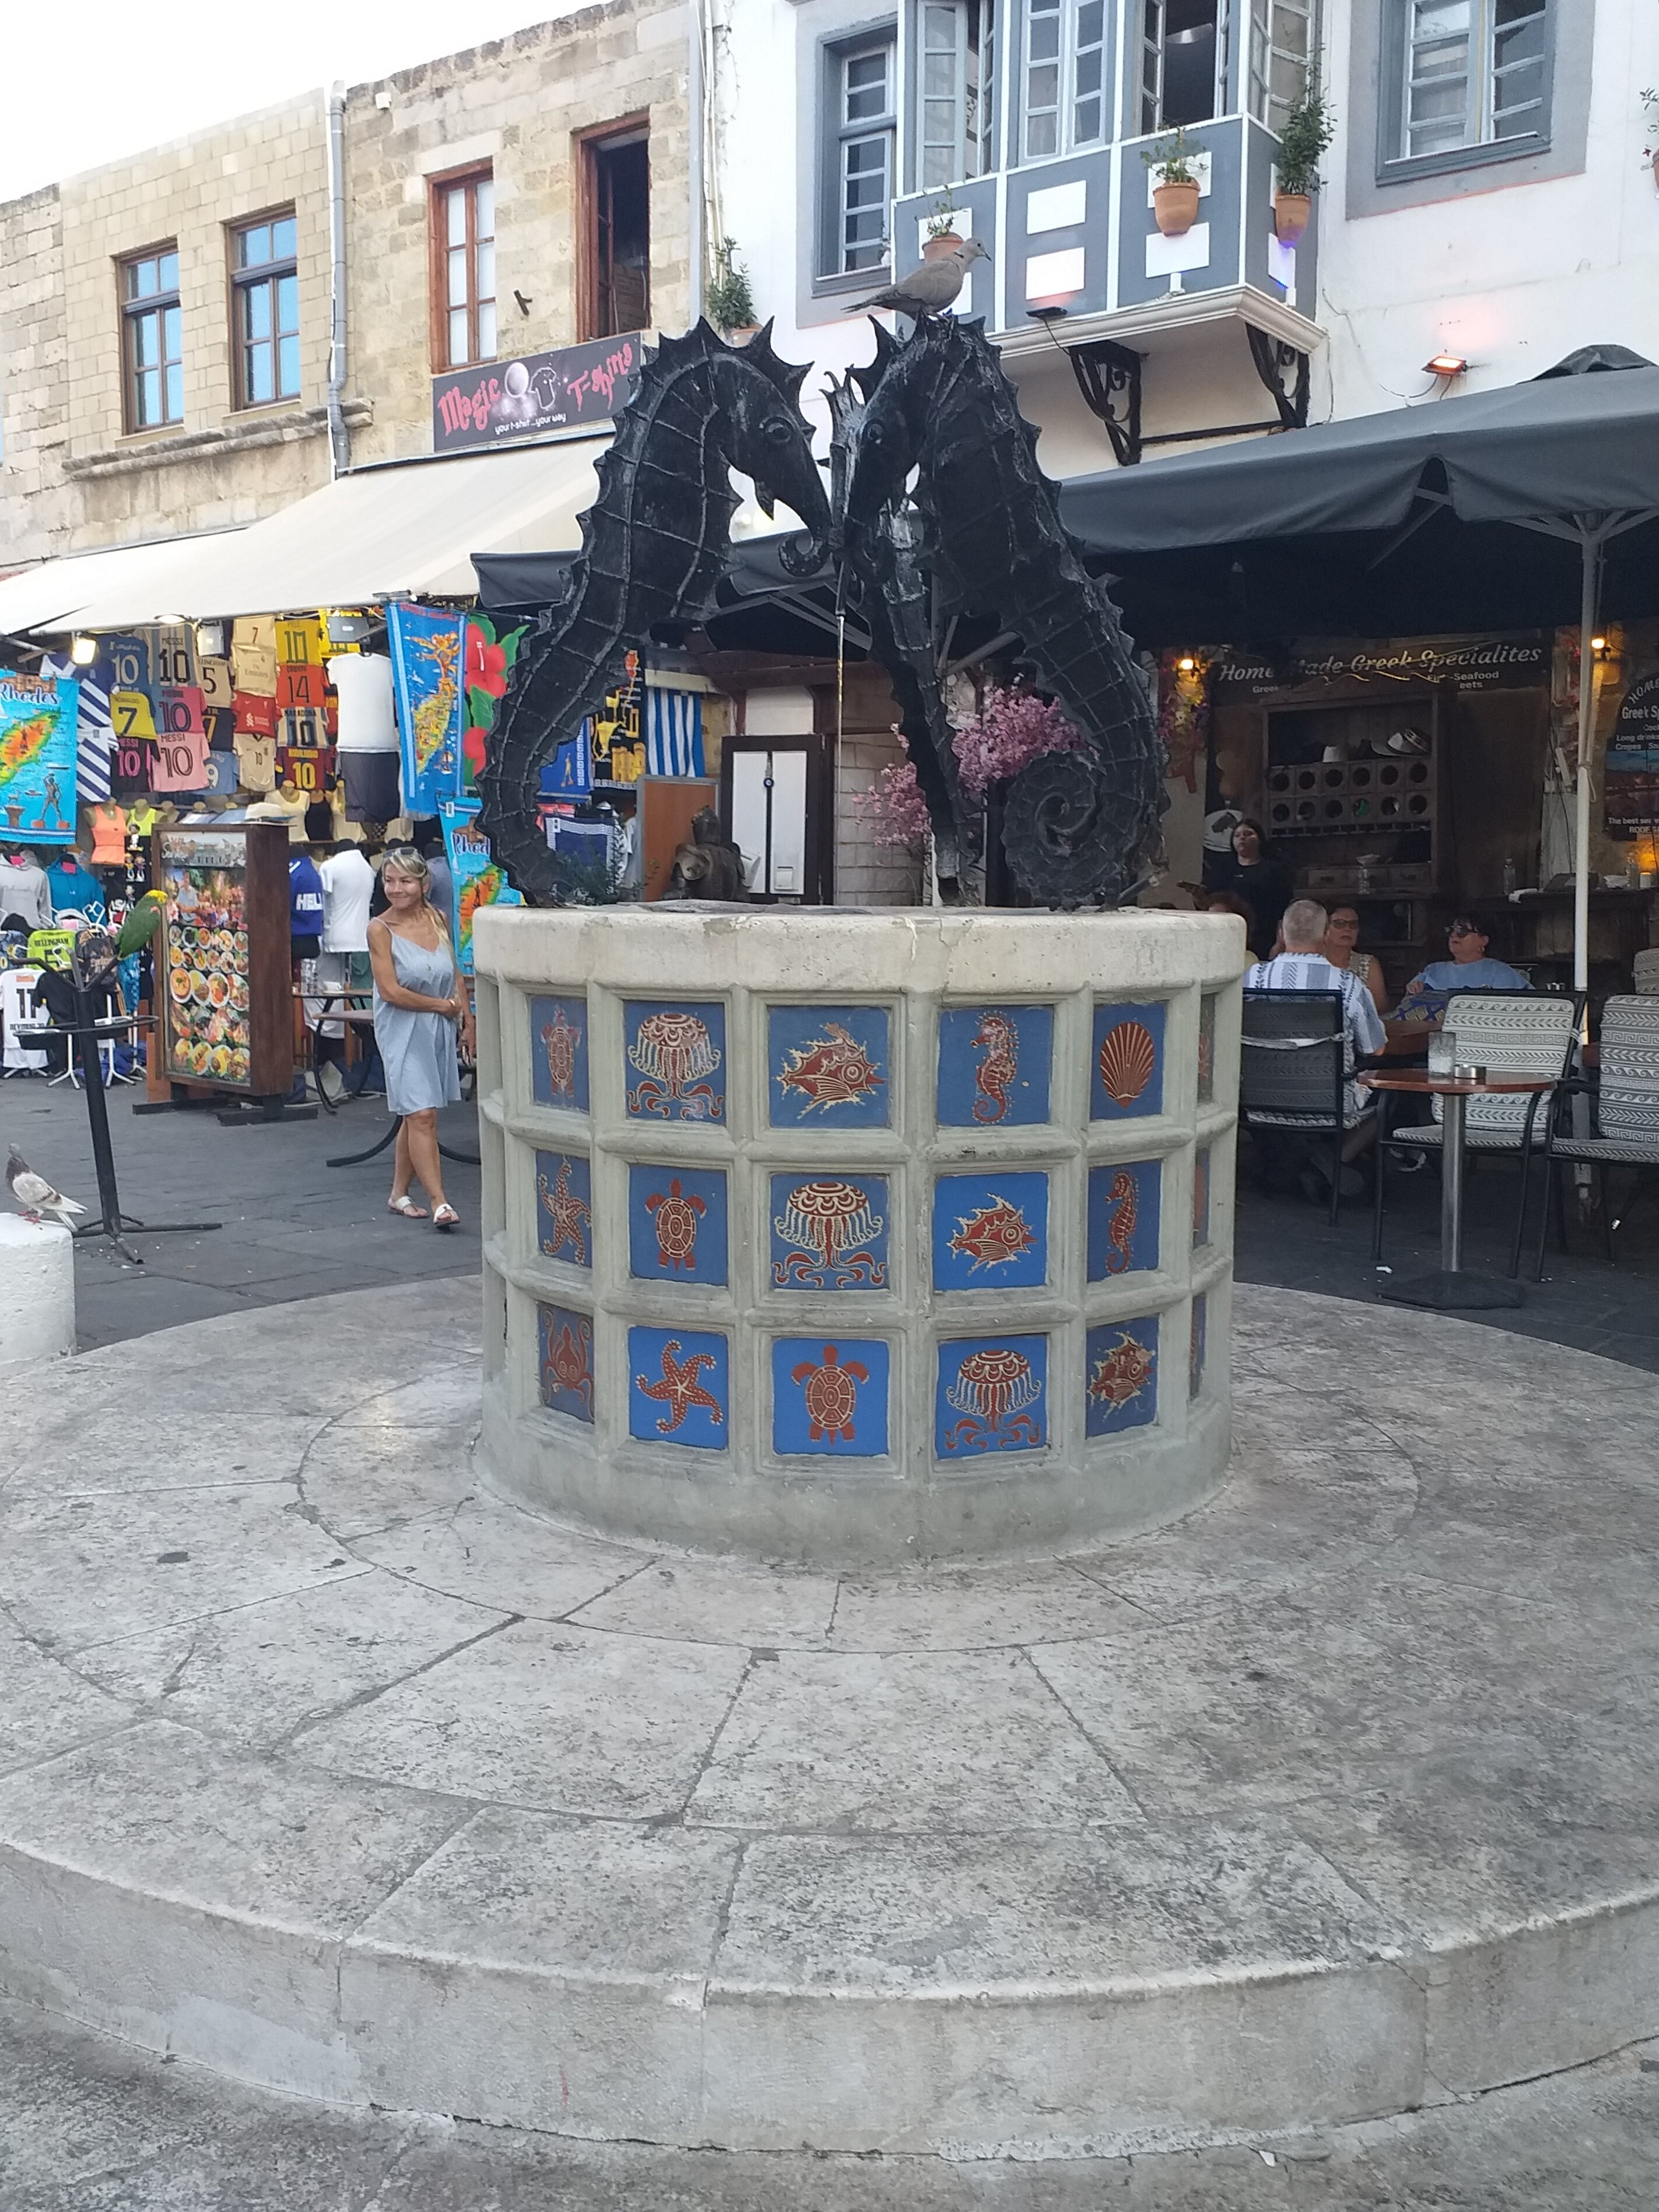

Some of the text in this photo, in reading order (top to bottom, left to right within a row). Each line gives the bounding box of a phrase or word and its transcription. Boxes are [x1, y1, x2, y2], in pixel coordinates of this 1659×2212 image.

[438, 378, 501, 436] Magic
[494, 424, 510, 435] your
[552, 413, 566, 423] way
[252, 626, 258, 643] 7
[285, 630, 308, 663] 10
[112, 654, 139, 685] 10
[159, 649, 190, 683] 10
[1351, 650, 1412, 672] Greek
[1419, 644, 1542, 672] Specialites
[0, 683, 59, 704] Rhodes
[202, 667, 216, 693] 5
[288, 676, 309, 703] 14
[118, 707, 138, 736] 7
[159, 701, 191, 732] 10
[202, 716, 216, 743] 7
[162, 734, 185, 742] MESSI
[289, 720, 315, 746] 10
[117, 750, 140, 776] 10
[160, 746, 193, 778] 10
[255, 752, 262, 765] 10
[205, 763, 218, 790] 9
[293, 762, 315, 789] 10
[451, 833, 491, 856] Rhod
[34, 938, 69, 947] BELLINGHAM
